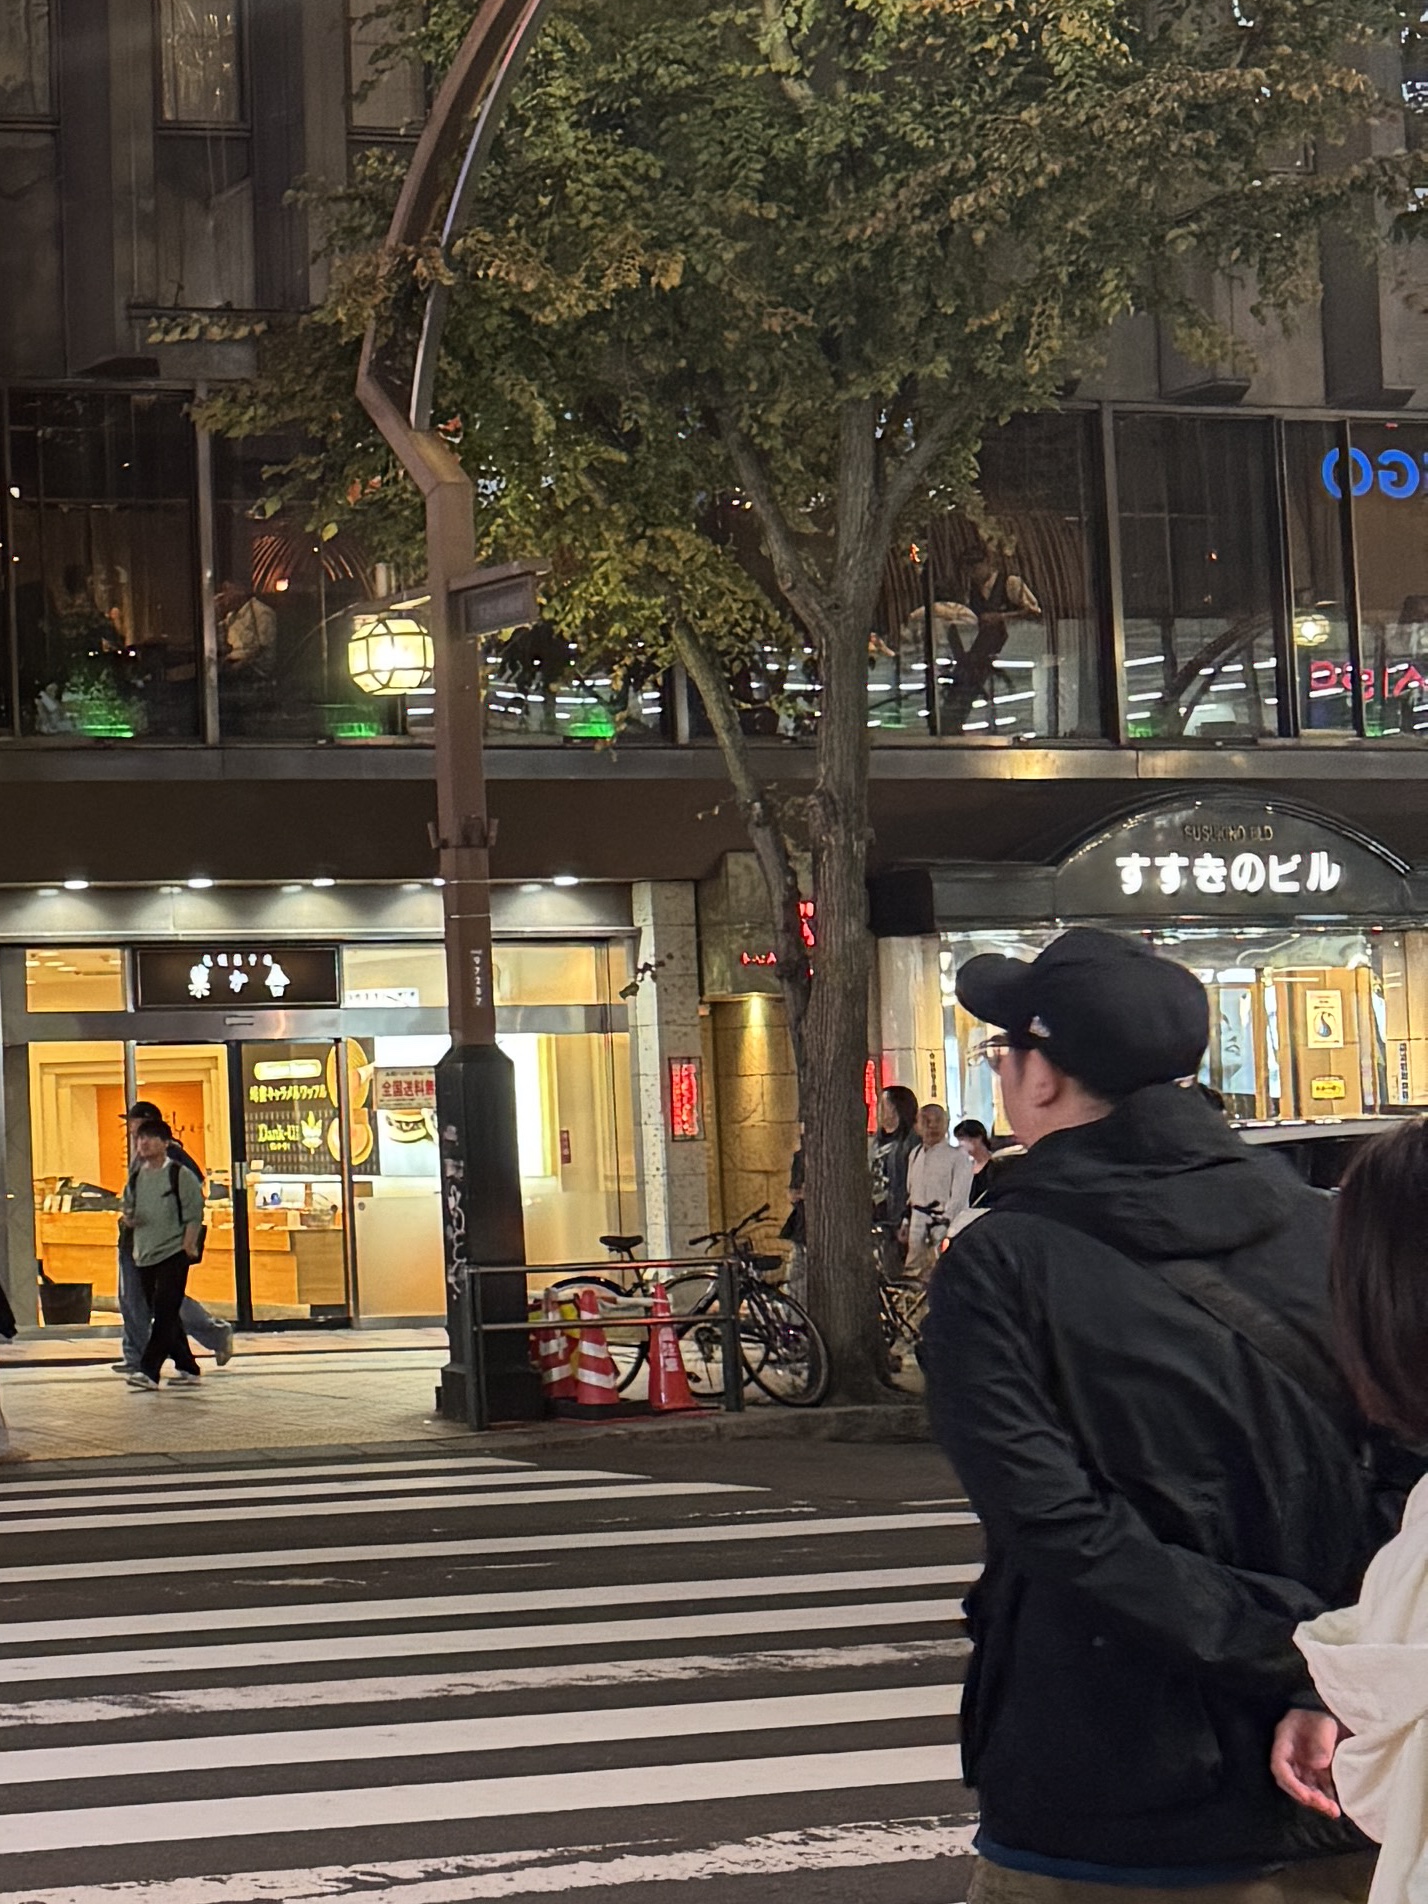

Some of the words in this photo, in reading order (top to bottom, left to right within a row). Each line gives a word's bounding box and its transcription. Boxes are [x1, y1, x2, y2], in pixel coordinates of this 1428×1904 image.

[1115, 851, 1341, 895] すすきのビル
